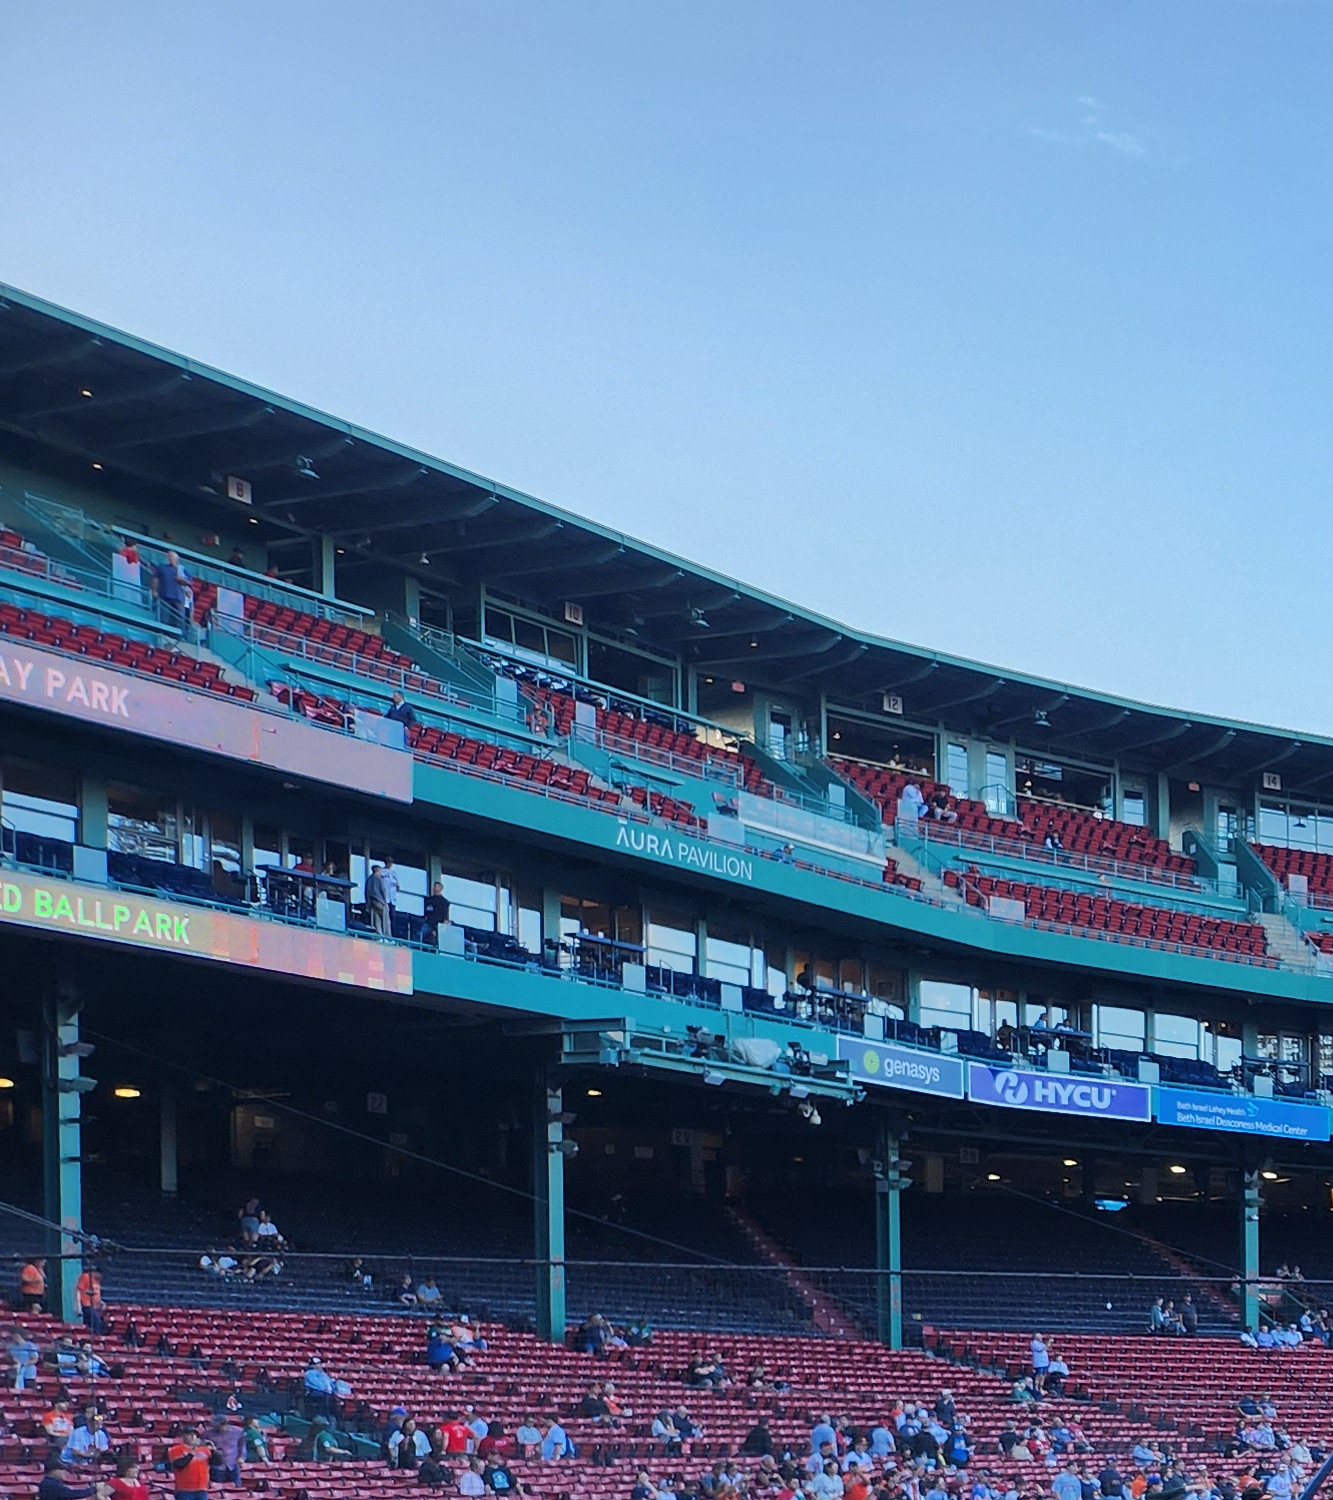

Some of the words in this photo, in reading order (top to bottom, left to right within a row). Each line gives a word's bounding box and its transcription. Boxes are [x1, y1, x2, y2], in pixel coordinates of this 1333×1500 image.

[568, 604, 579, 621] 10
[46, 666, 130, 718] PARK
[888, 697, 899, 711] 12
[1267, 775, 1278, 788] 14
[678, 842, 753, 881] PAVILION
[34, 888, 191, 945] BALLPARK
[884, 1057, 941, 1086] genasys
[1034, 1080, 1112, 1110] HYCU
[1177, 1113, 1196, 1125] Beth
[1196, 1115, 1215, 1127] Israel
[1215, 1117, 1255, 1131] Deaconess
[1255, 1121, 1283, 1134] Medical
[1283, 1123, 1308, 1136] Center
